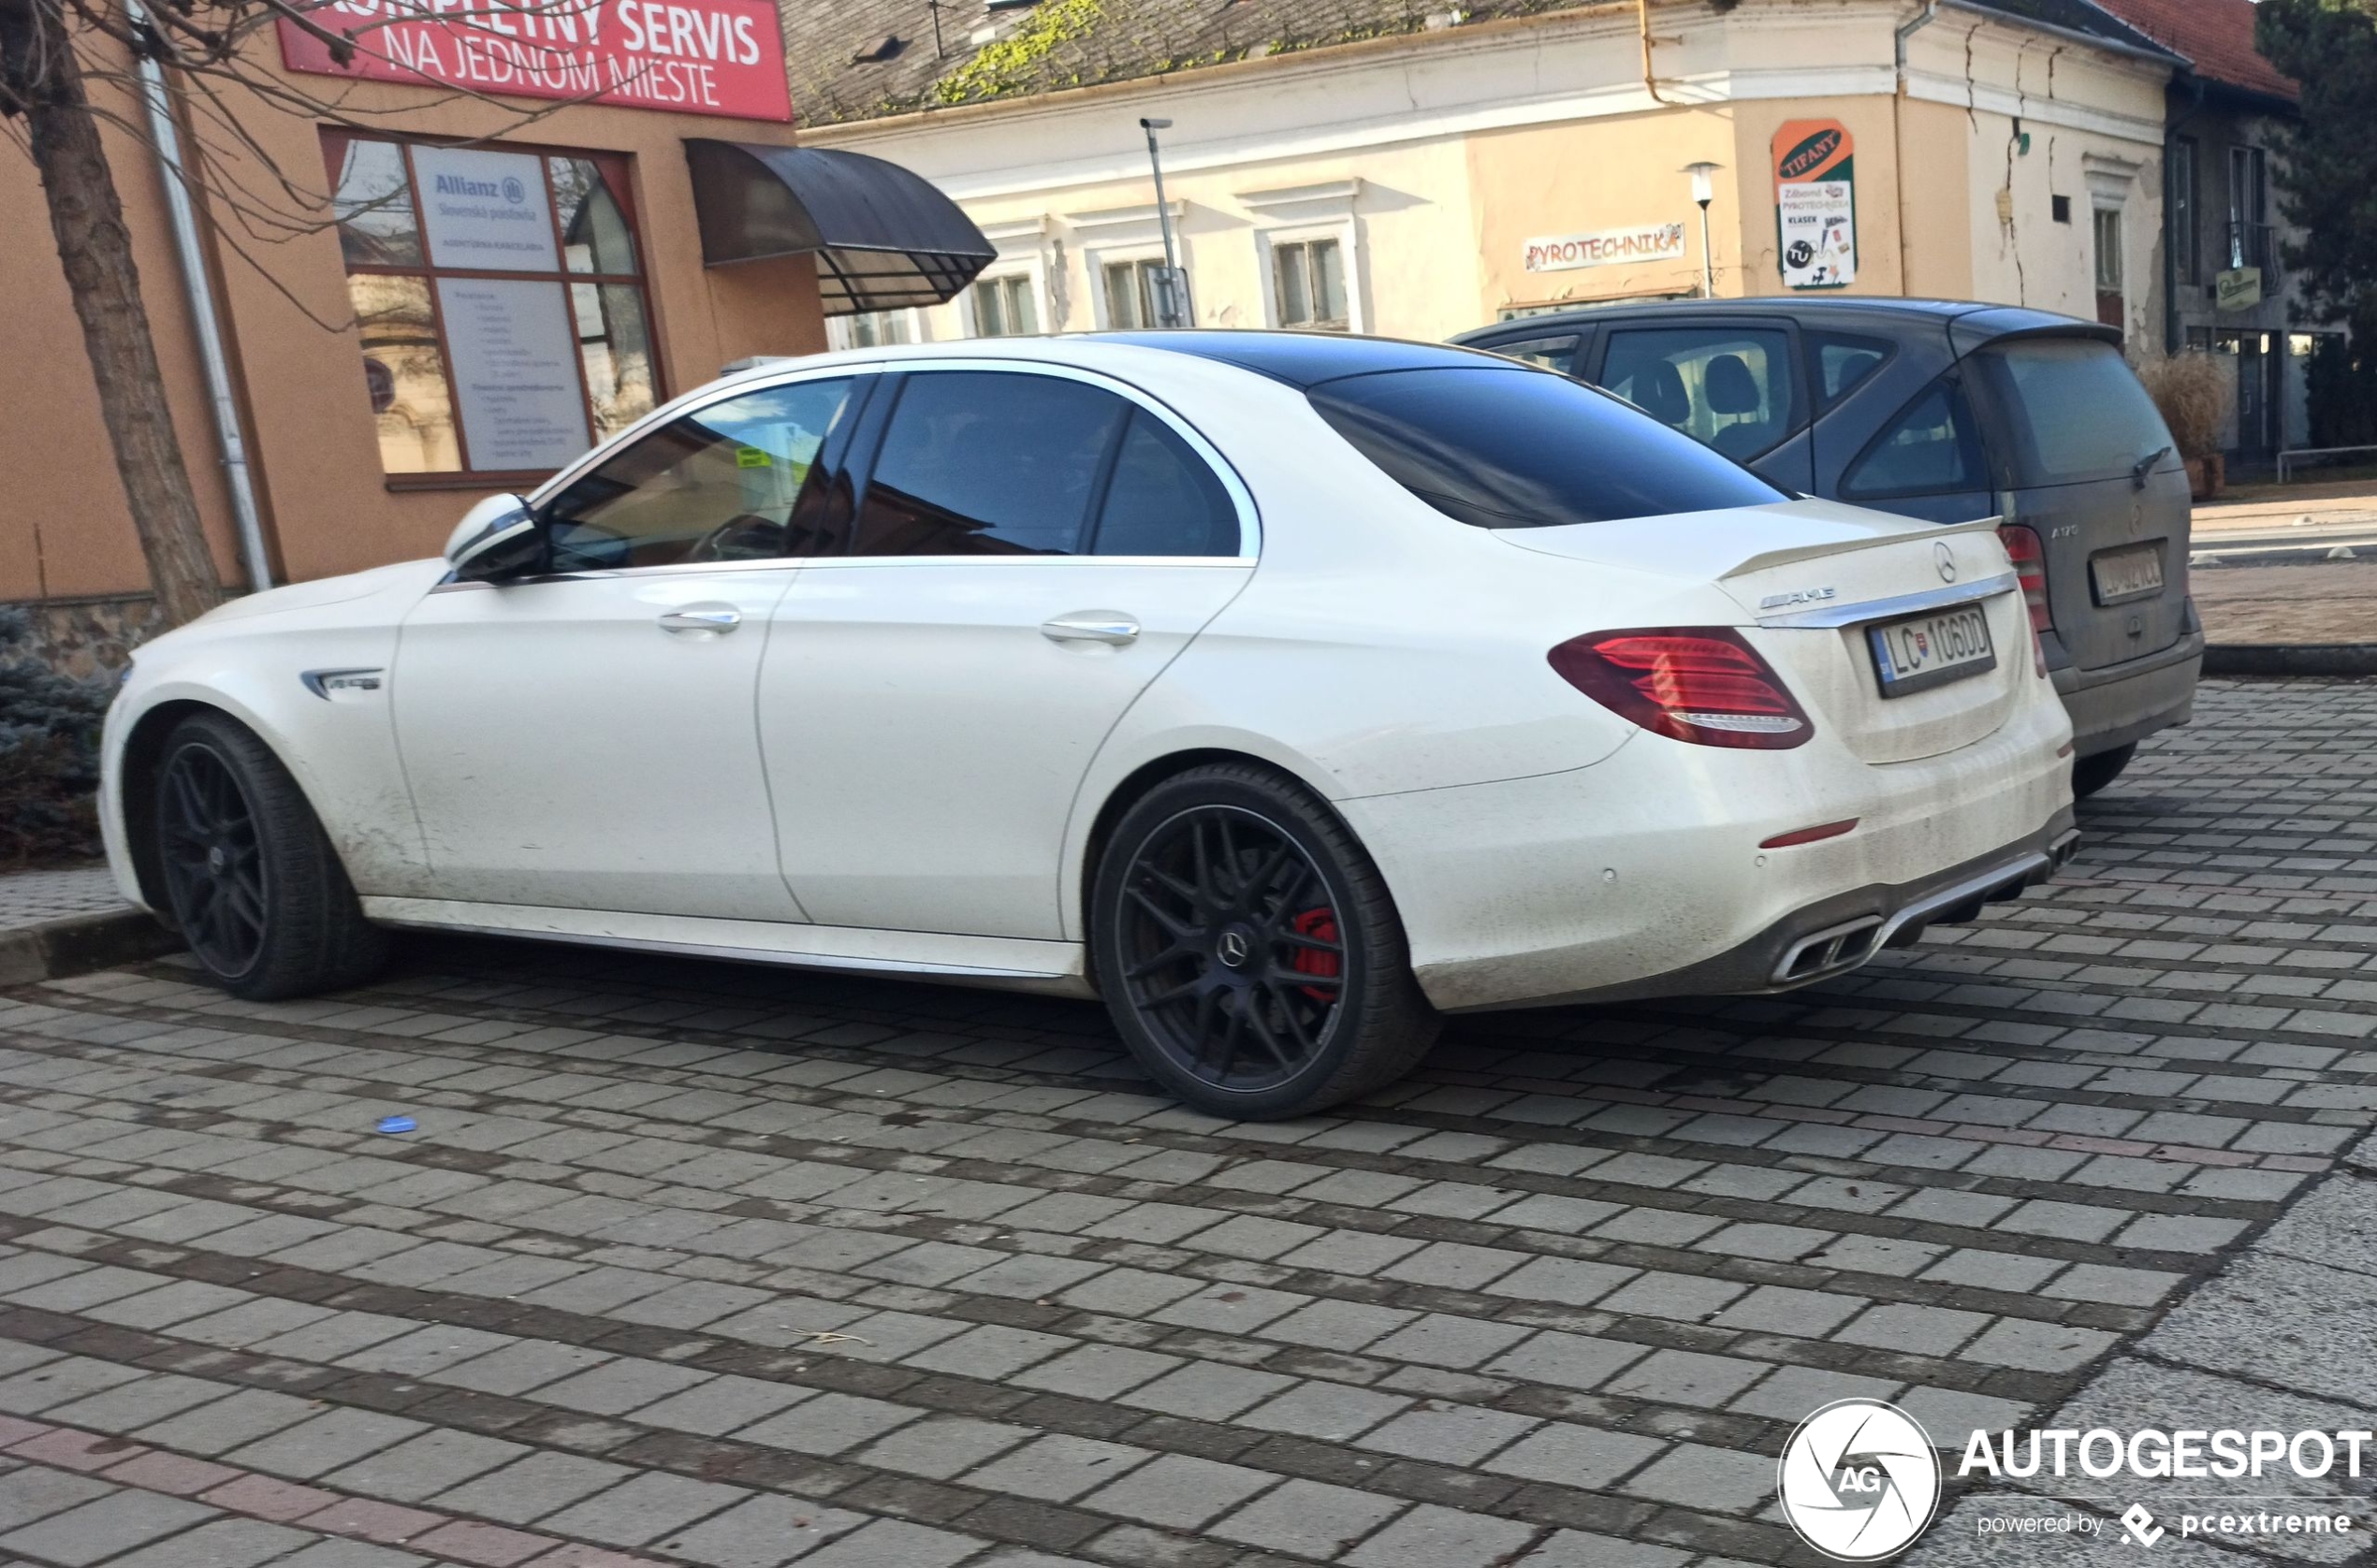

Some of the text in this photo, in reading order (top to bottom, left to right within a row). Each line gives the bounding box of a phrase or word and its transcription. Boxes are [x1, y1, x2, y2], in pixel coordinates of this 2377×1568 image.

[321, 0, 760, 65] LETNY SERVIS
[383, 24, 721, 107] NA JEDNOM MIESTE
[436, 174, 500, 197] Allianz
[1527, 232, 1681, 265] PYROTECHNIKA
[1886, 612, 1988, 674] LC 106DD
